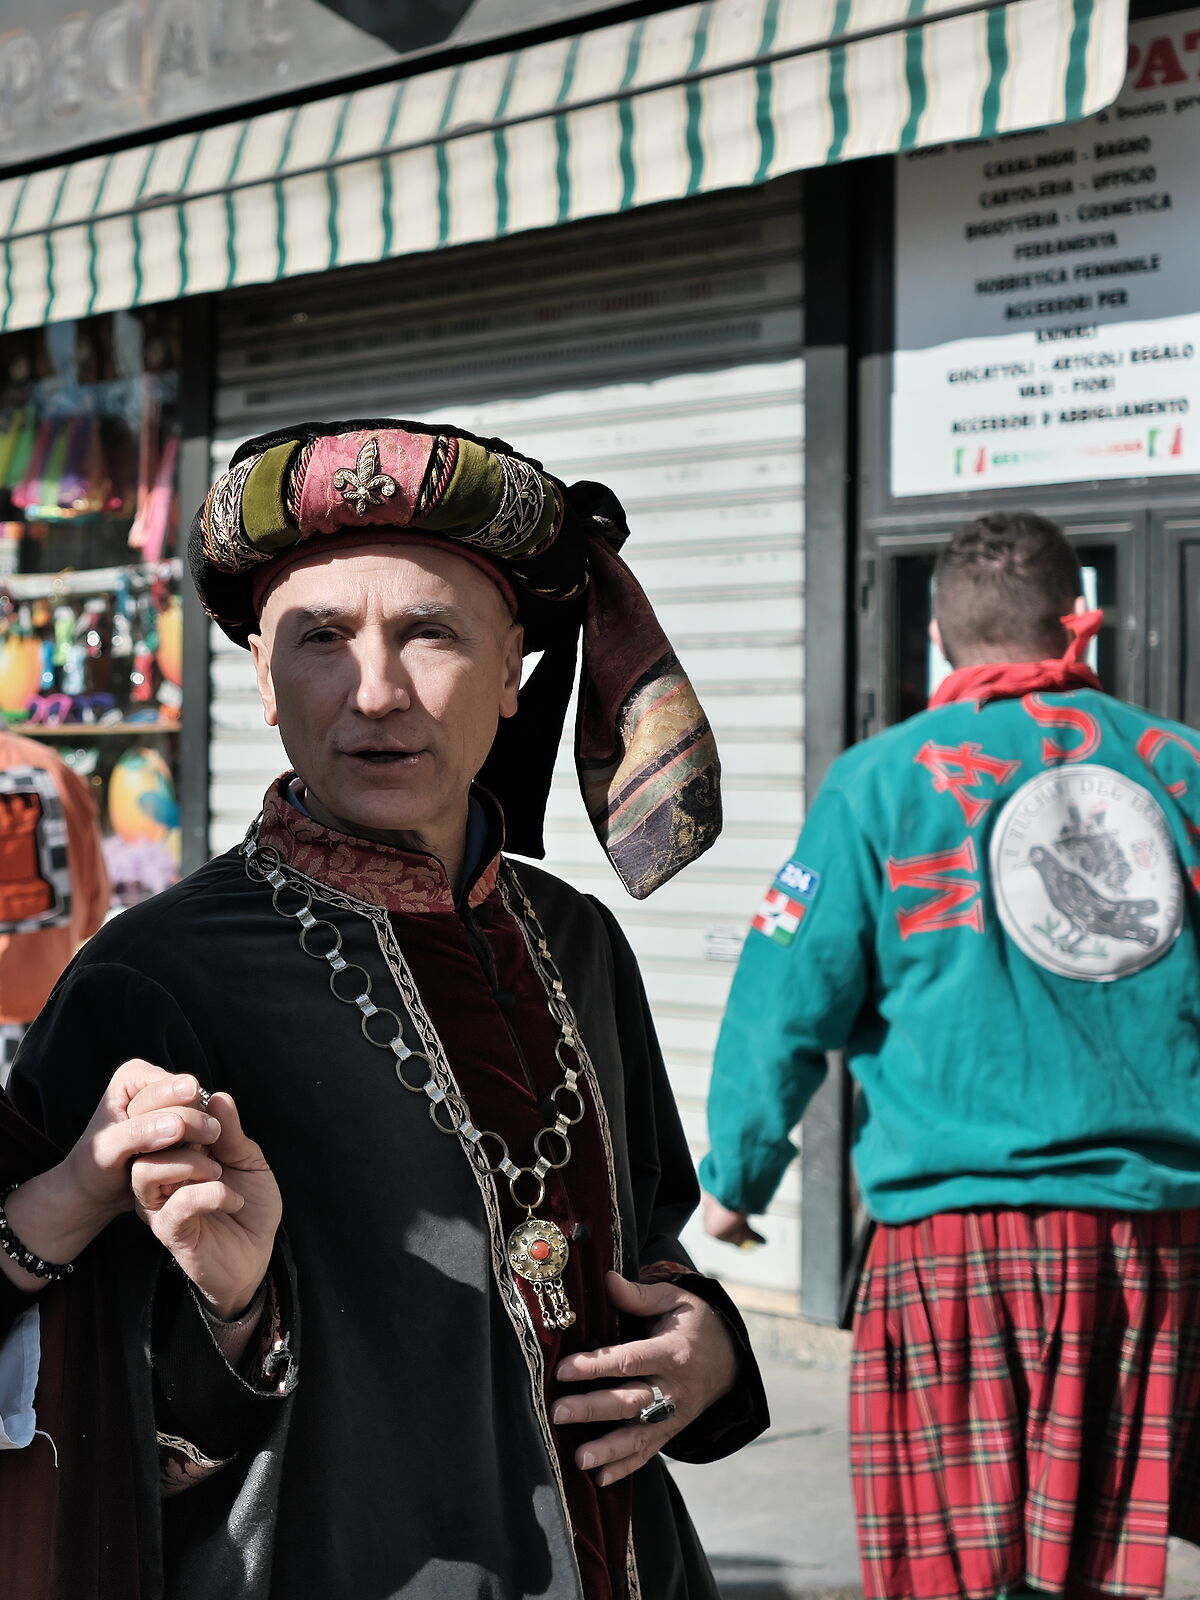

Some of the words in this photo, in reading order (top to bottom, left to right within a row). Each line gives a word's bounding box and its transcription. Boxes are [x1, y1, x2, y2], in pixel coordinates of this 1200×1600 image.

[979, 178, 1074, 209] CARTOLERIA
[1092, 164, 1156, 190] UFFICIO
[1077, 192, 1172, 222] COSMETICA
[1014, 230, 1118, 260] FERRAMENTA
[1073, 254, 1161, 280] FEMMINILE
[1004, 294, 1092, 320] ACCESSORI
[1097, 288, 1128, 307] PER
[1052, 351, 1124, 371] ARTICOLI
[1130, 343, 1194, 364] REGALO
[1073, 376, 1115, 393] FIORI
